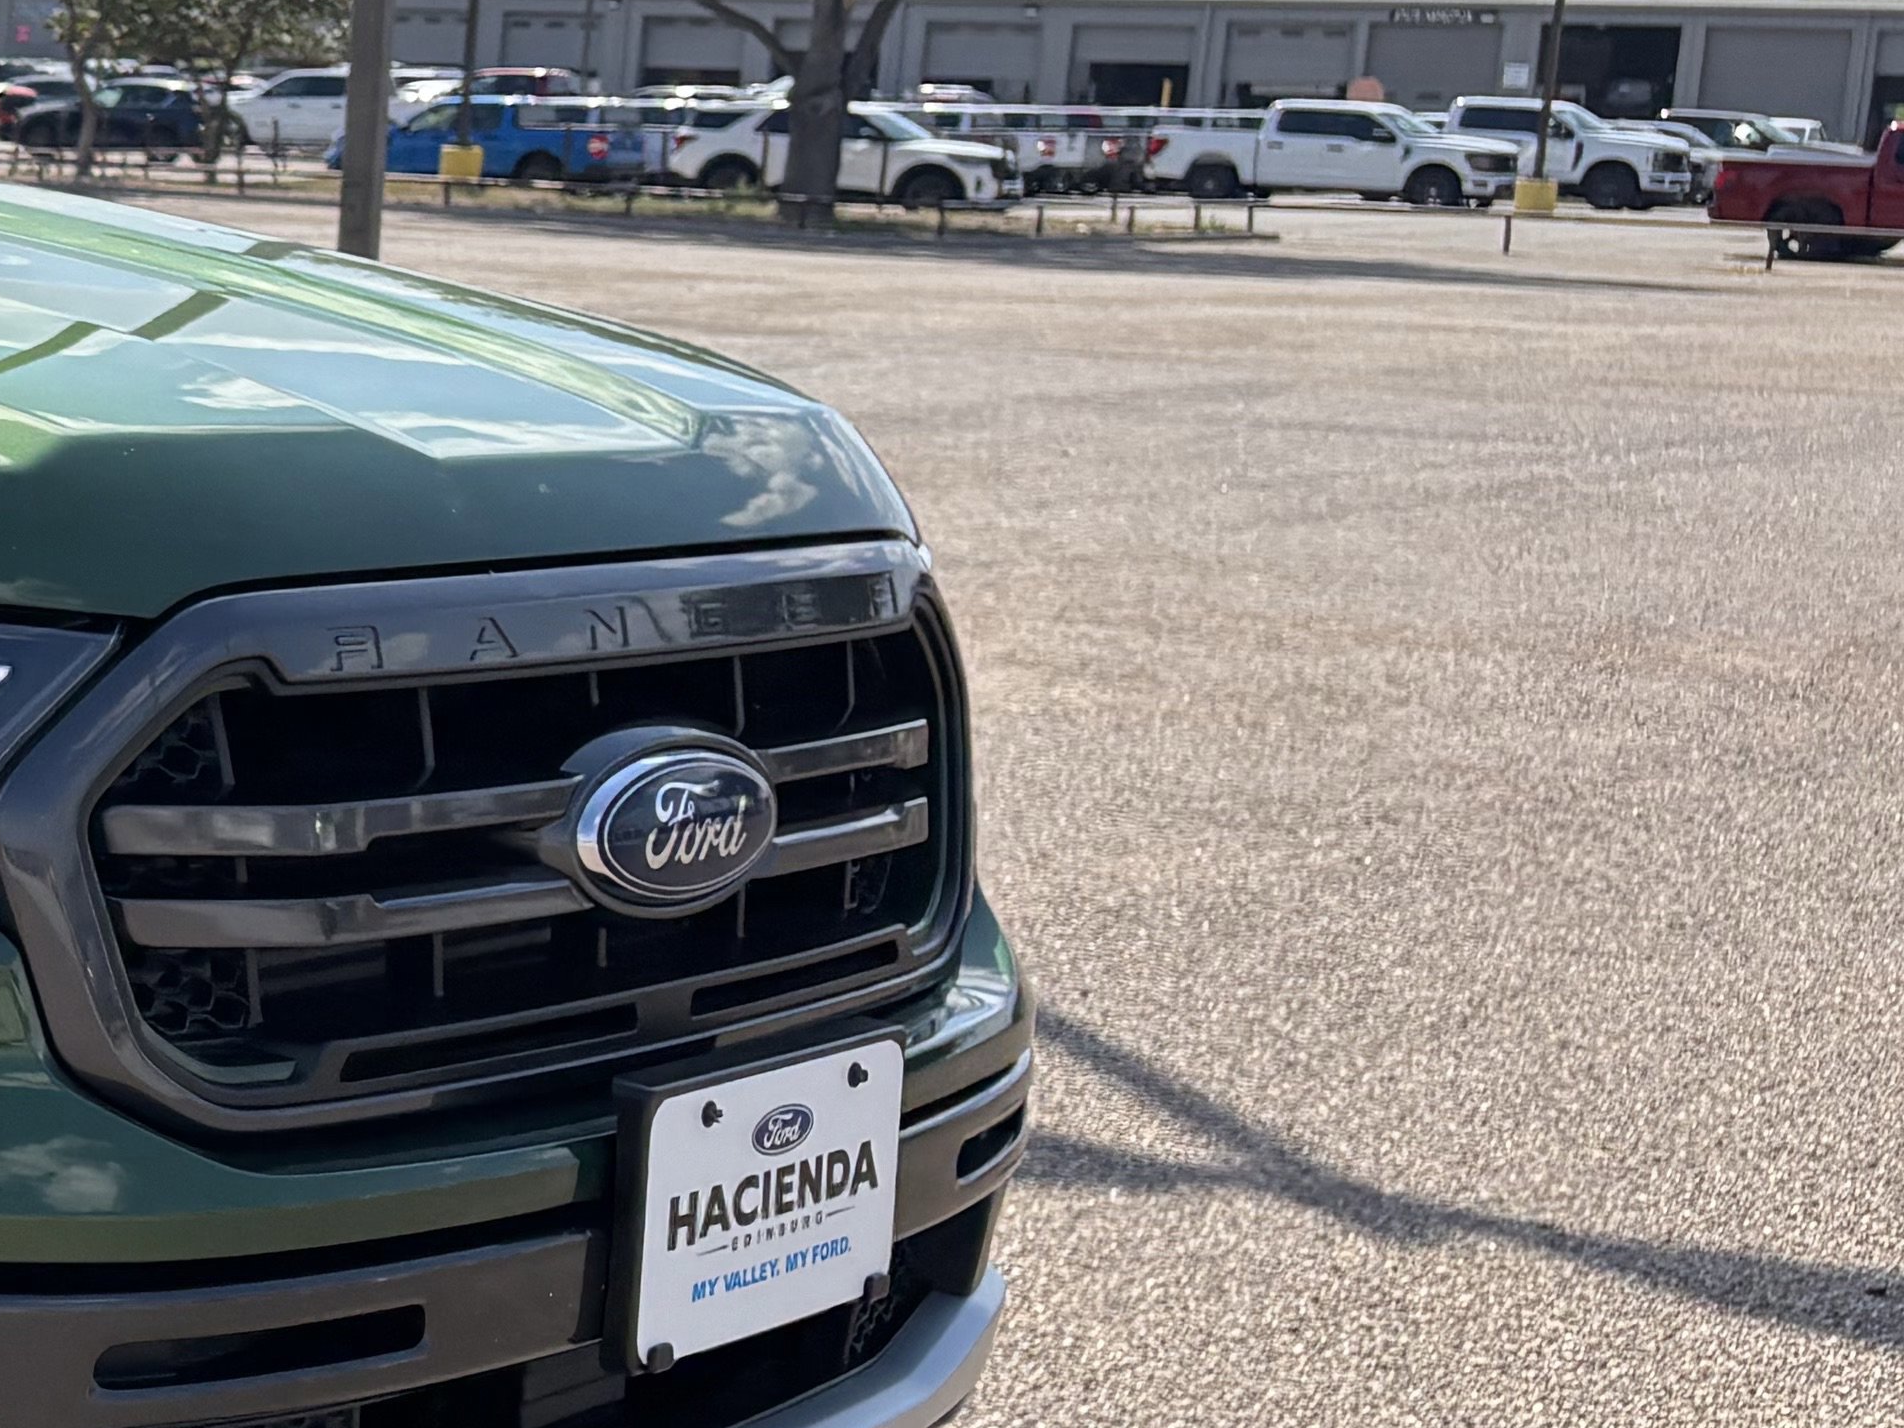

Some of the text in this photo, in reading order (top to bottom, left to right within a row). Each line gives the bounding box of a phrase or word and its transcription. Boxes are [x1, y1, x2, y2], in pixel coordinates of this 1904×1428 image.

[644, 778, 748, 871] Ford
[762, 1111, 804, 1149] Ford
[667, 1139, 879, 1252] HACIENDA
[730, 1210, 824, 1253] EDINBURG
[691, 1235, 852, 1303] MY VALLEY. MY FORD.
